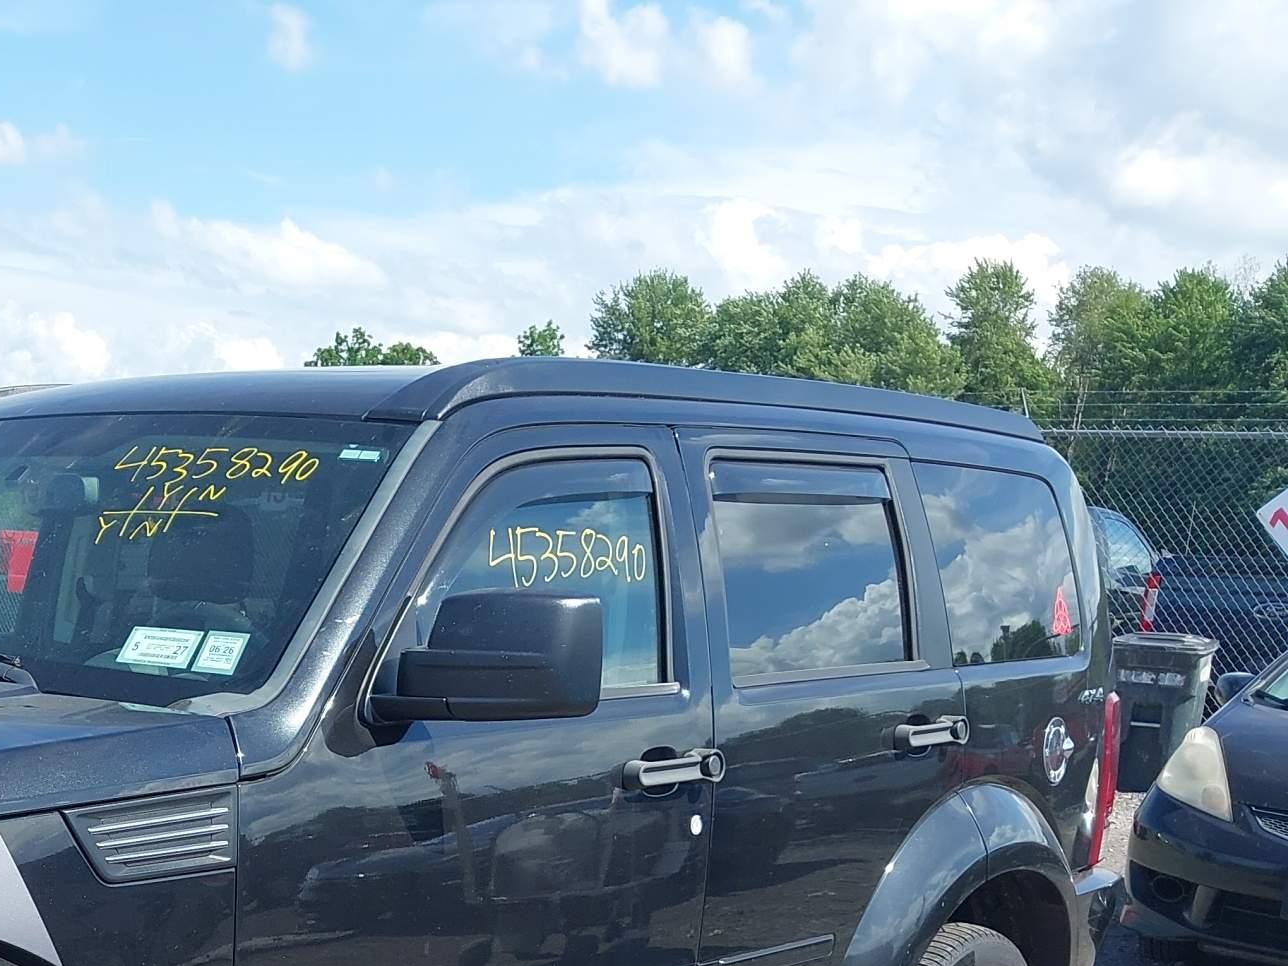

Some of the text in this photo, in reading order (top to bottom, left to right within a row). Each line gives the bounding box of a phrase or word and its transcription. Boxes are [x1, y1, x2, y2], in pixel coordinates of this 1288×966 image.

[114, 446, 320, 485] 45358290
[488, 526, 646, 588] 45358290
[172, 645, 189, 656] 27
